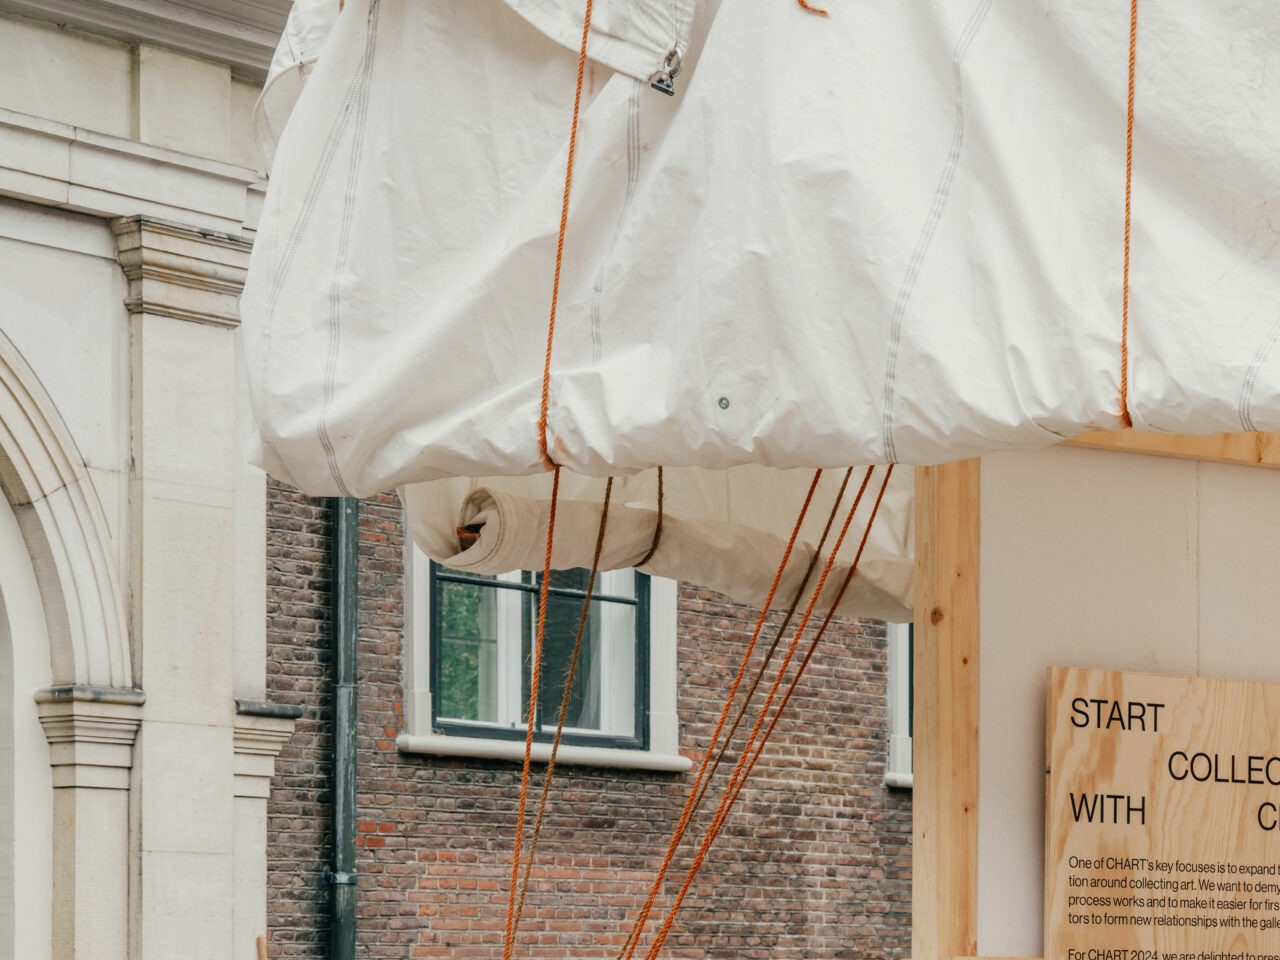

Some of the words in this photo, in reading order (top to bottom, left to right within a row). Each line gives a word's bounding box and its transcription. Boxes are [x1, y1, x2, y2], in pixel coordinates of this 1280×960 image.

[1070, 697, 1165, 733] START
[1069, 792, 1146, 825] WITH
[1068, 855, 1091, 869] One
[1093, 856, 1103, 869] of
[1155, 858, 1173, 874] key
[1175, 858, 1215, 872] focuses
[1217, 860, 1225, 873] is
[1227, 860, 1237, 873] to
[1238, 860, 1275, 877] expand
[1068, 874, 1088, 887] tion
[1090, 874, 1127, 888] around
[1129, 875, 1178, 893] collecting
[1180, 877, 1196, 890] art.
[1198, 877, 1215, 890] We
[1216, 878, 1240, 891] want
[1243, 878, 1252, 891] to
[1068, 911, 1089, 924] tors
[1091, 911, 1101, 924] to
[1104, 911, 1128, 925] form
[1129, 915, 1151, 925] new
[1153, 912, 1217, 930] relationships
[1219, 914, 1240, 927] with
[1242, 914, 1257, 927] the
[1068, 948, 1084, 960] For
